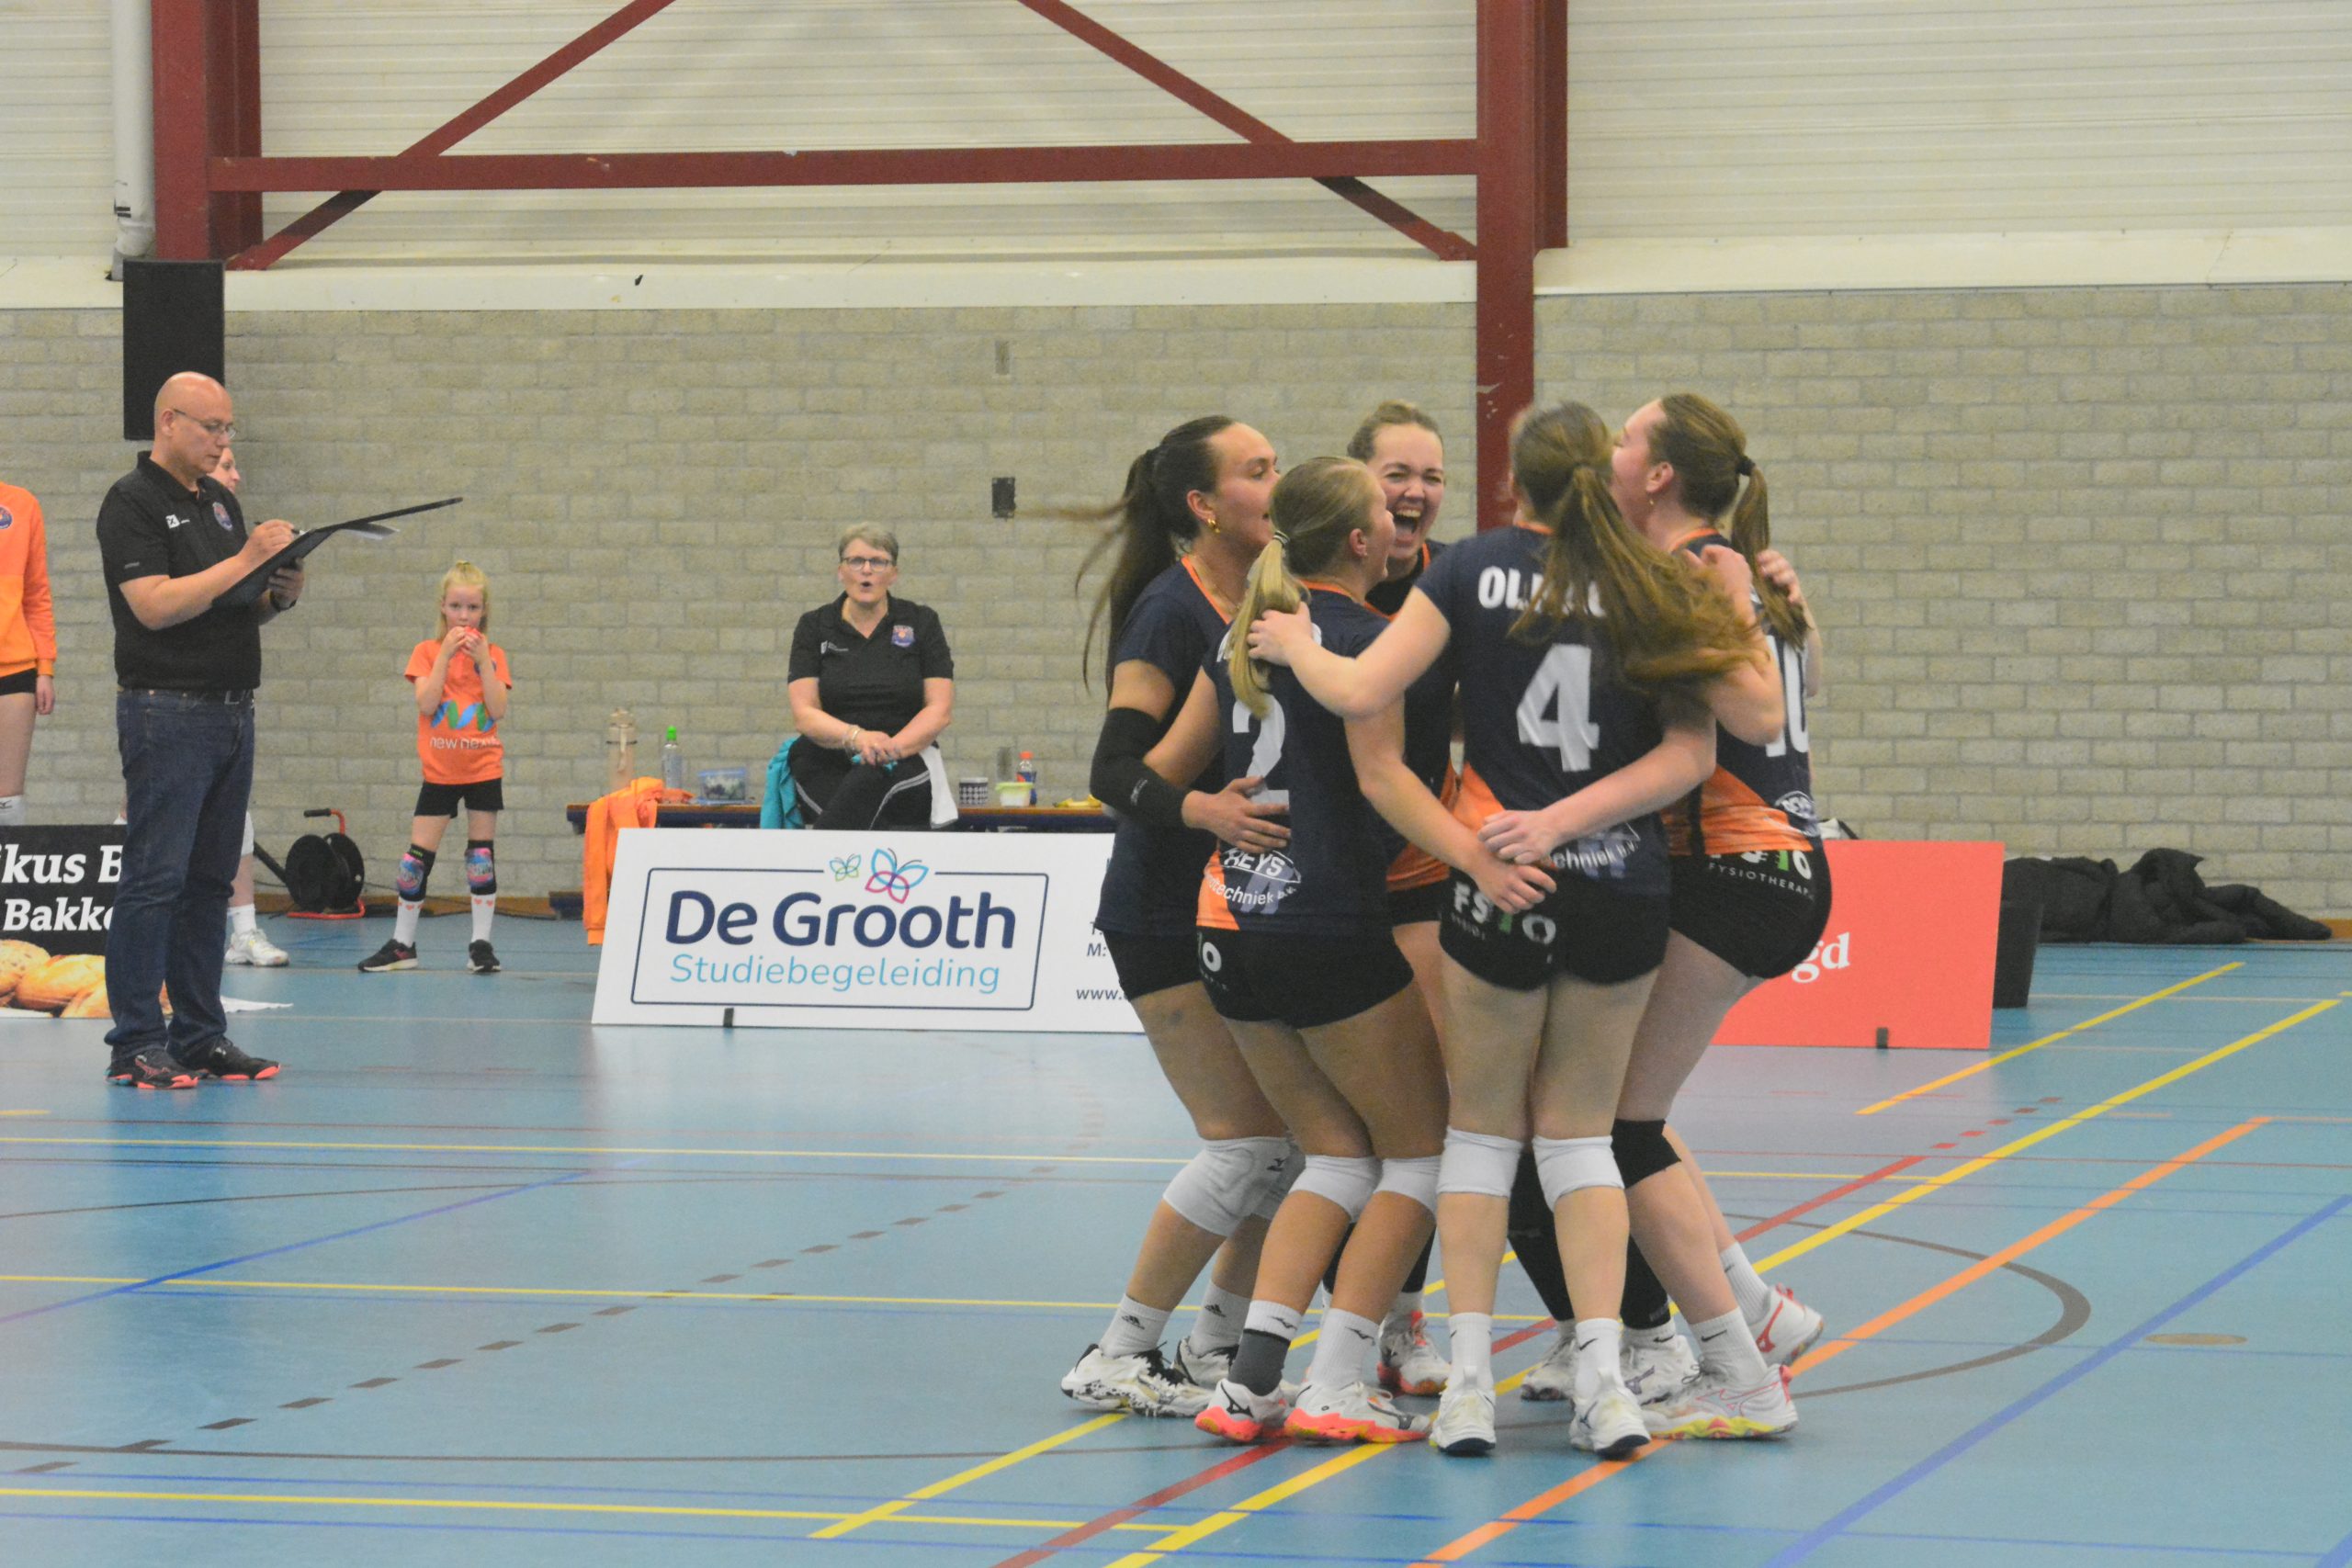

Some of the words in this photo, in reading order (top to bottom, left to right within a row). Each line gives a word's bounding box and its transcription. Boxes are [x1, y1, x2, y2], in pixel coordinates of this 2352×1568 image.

[1517, 644, 1600, 773] 4
[1232, 694, 1290, 810] 2
[0, 843, 86, 884] kus
[665, 890, 757, 947] De
[773, 892, 1016, 950] Grooth
[670, 953, 1001, 994] Studiebegeleiding
